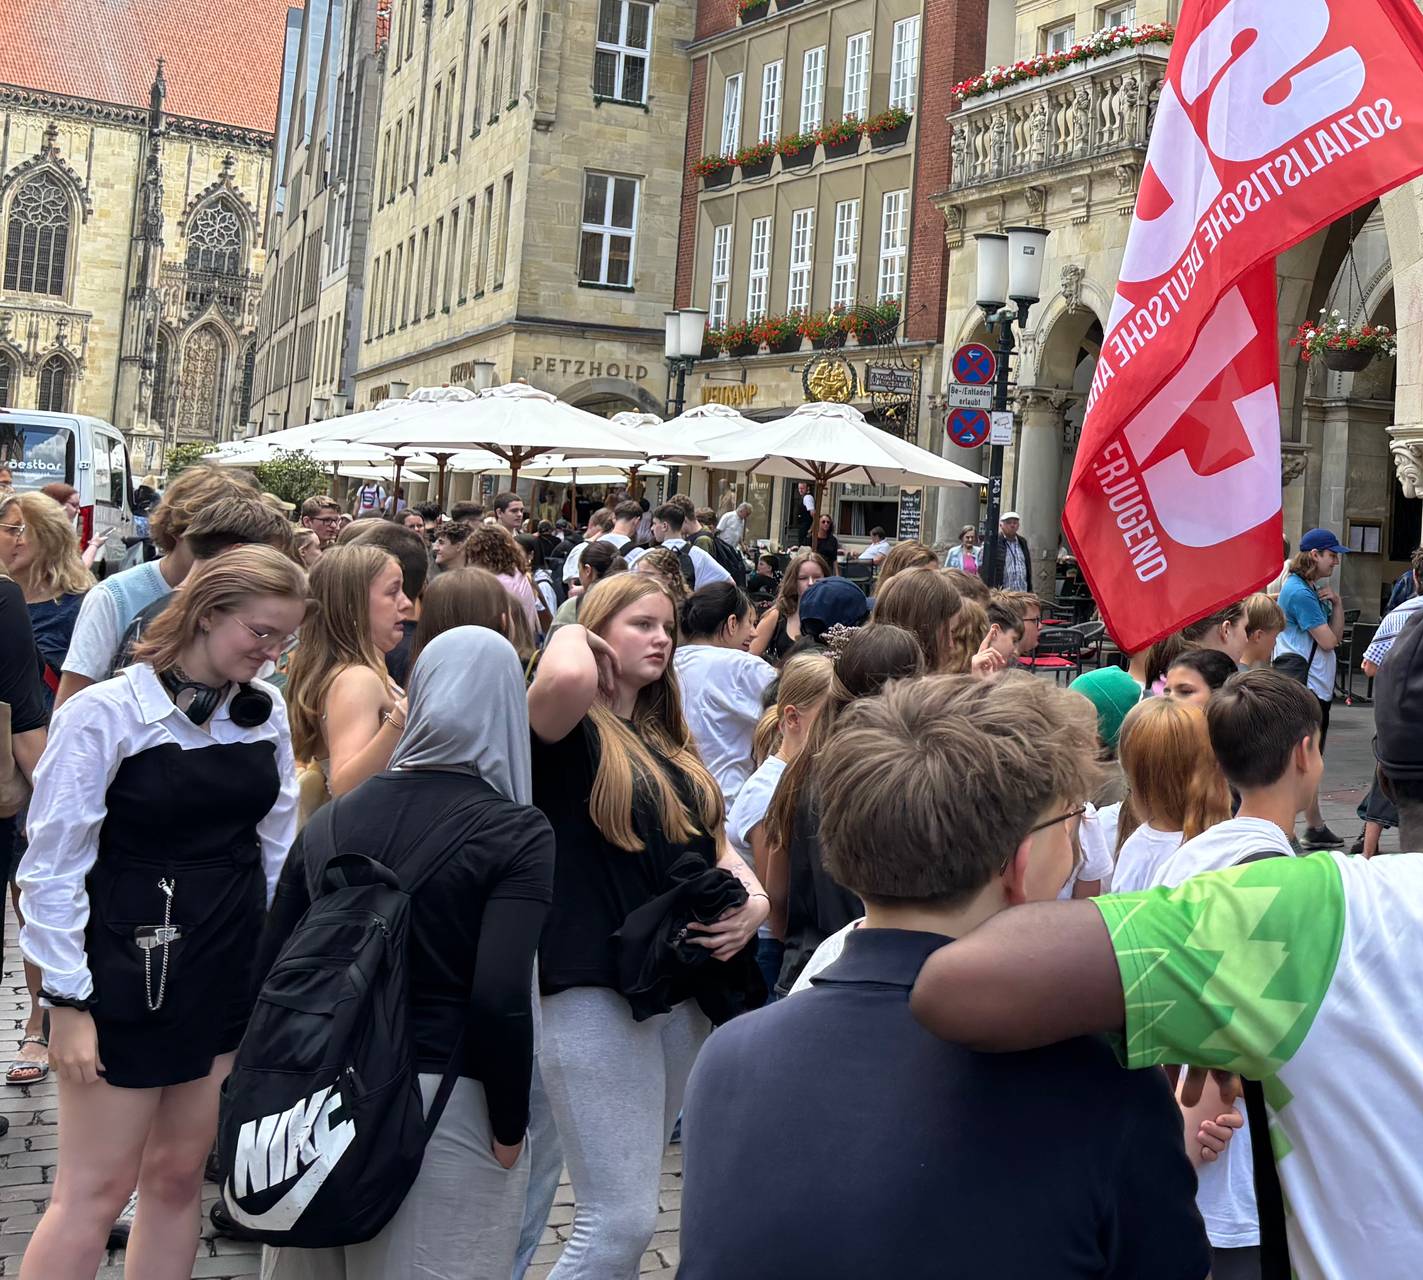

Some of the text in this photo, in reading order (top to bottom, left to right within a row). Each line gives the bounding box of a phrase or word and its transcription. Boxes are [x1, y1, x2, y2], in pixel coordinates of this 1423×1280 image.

[533, 356, 648, 380] PETZHOLD
[950, 386, 991, 397] Be-/Entladen
[959, 398, 981, 406] erlaubt
[234, 1085, 354, 1200] NIKE
